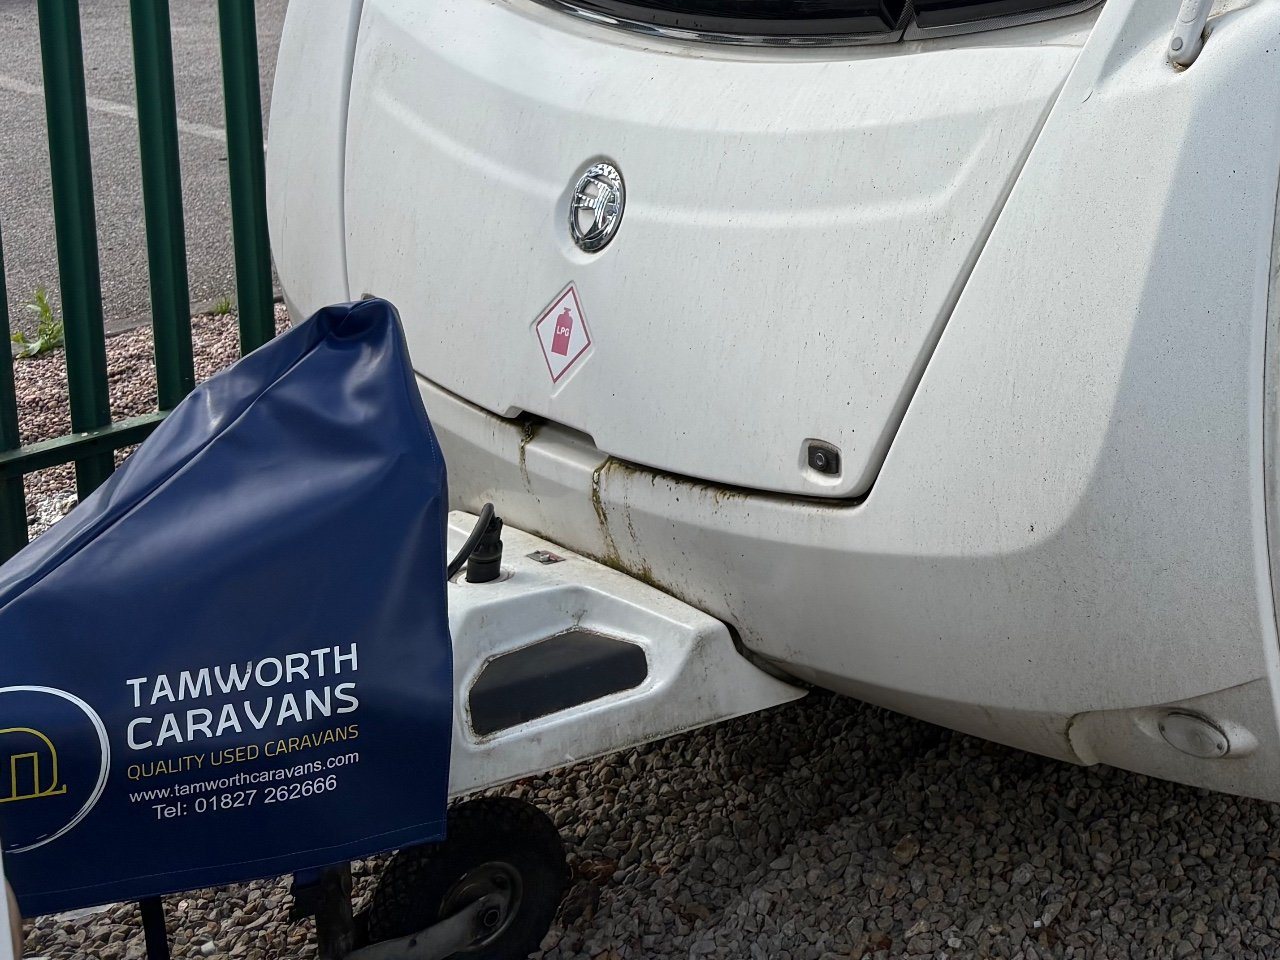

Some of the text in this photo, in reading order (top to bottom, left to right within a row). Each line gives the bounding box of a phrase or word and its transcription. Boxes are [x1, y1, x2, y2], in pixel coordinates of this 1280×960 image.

[556, 325, 570, 337] LPG
[126, 642, 358, 708] TAMWORTH
[126, 682, 360, 750] CARAVANS
[127, 724, 360, 781] QUALITY USED CARAVANS
[129, 752, 360, 803] www.tamworthcaravans.com
[152, 774, 338, 820] Tel: 01827 262666
